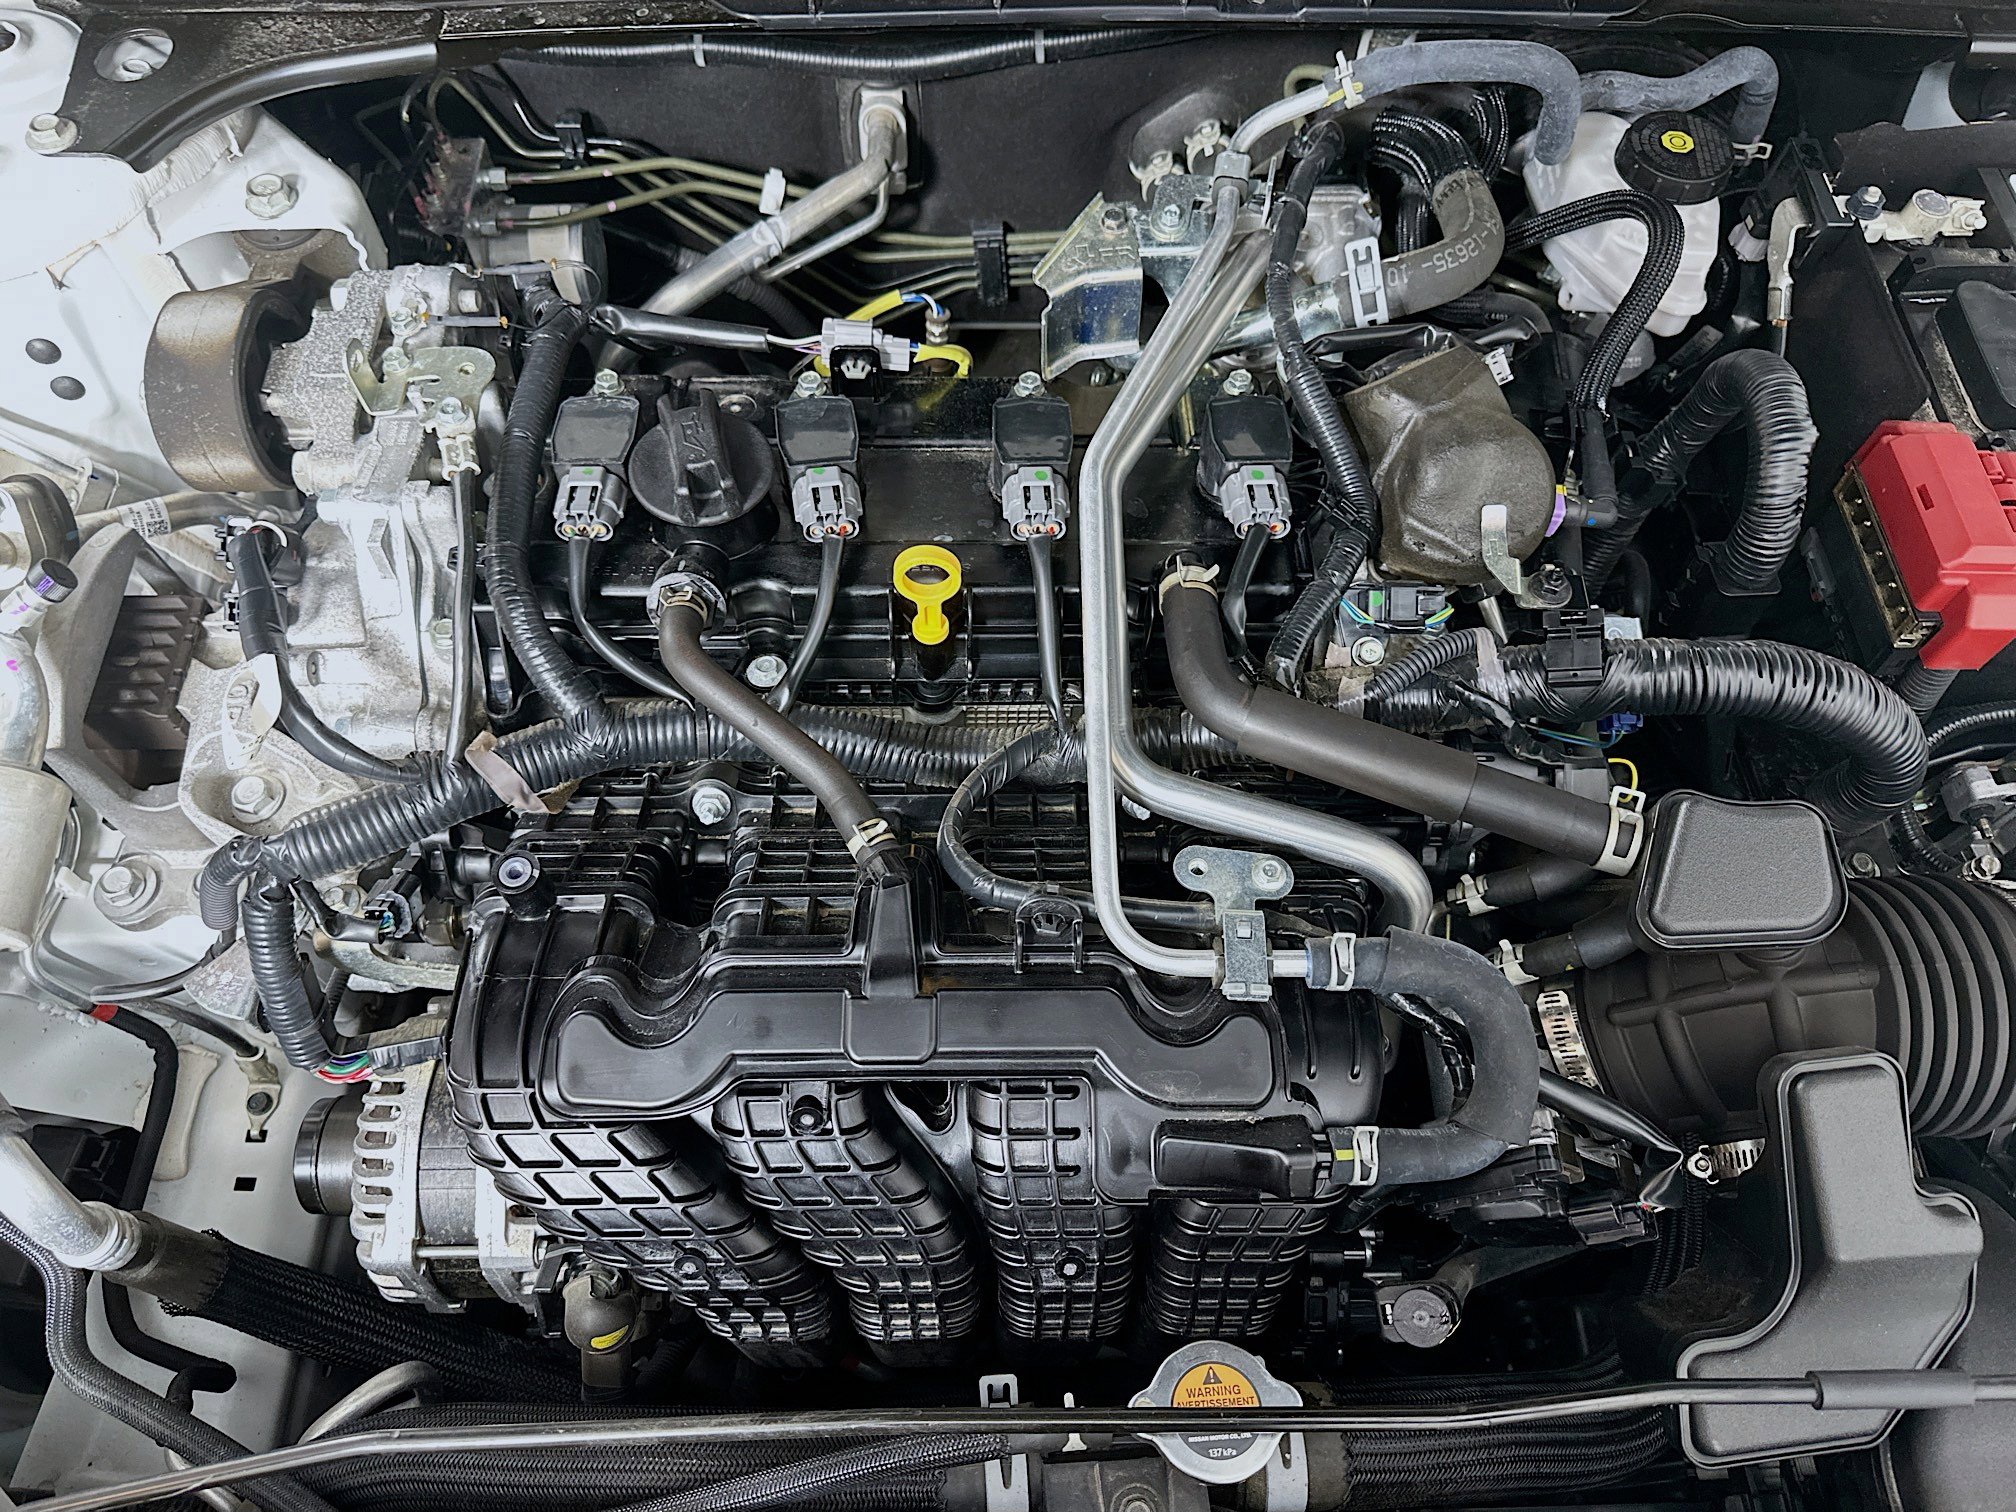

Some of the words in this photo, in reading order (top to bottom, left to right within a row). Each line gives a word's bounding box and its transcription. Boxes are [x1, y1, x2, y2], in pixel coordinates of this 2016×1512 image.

[1186, 1384, 1241, 1398] WARNING
[1177, 1396, 1254, 1407] AVERTISSEMENT
[1208, 1448, 1222, 1457] 137
[1222, 1448, 1237, 1457] kPa
